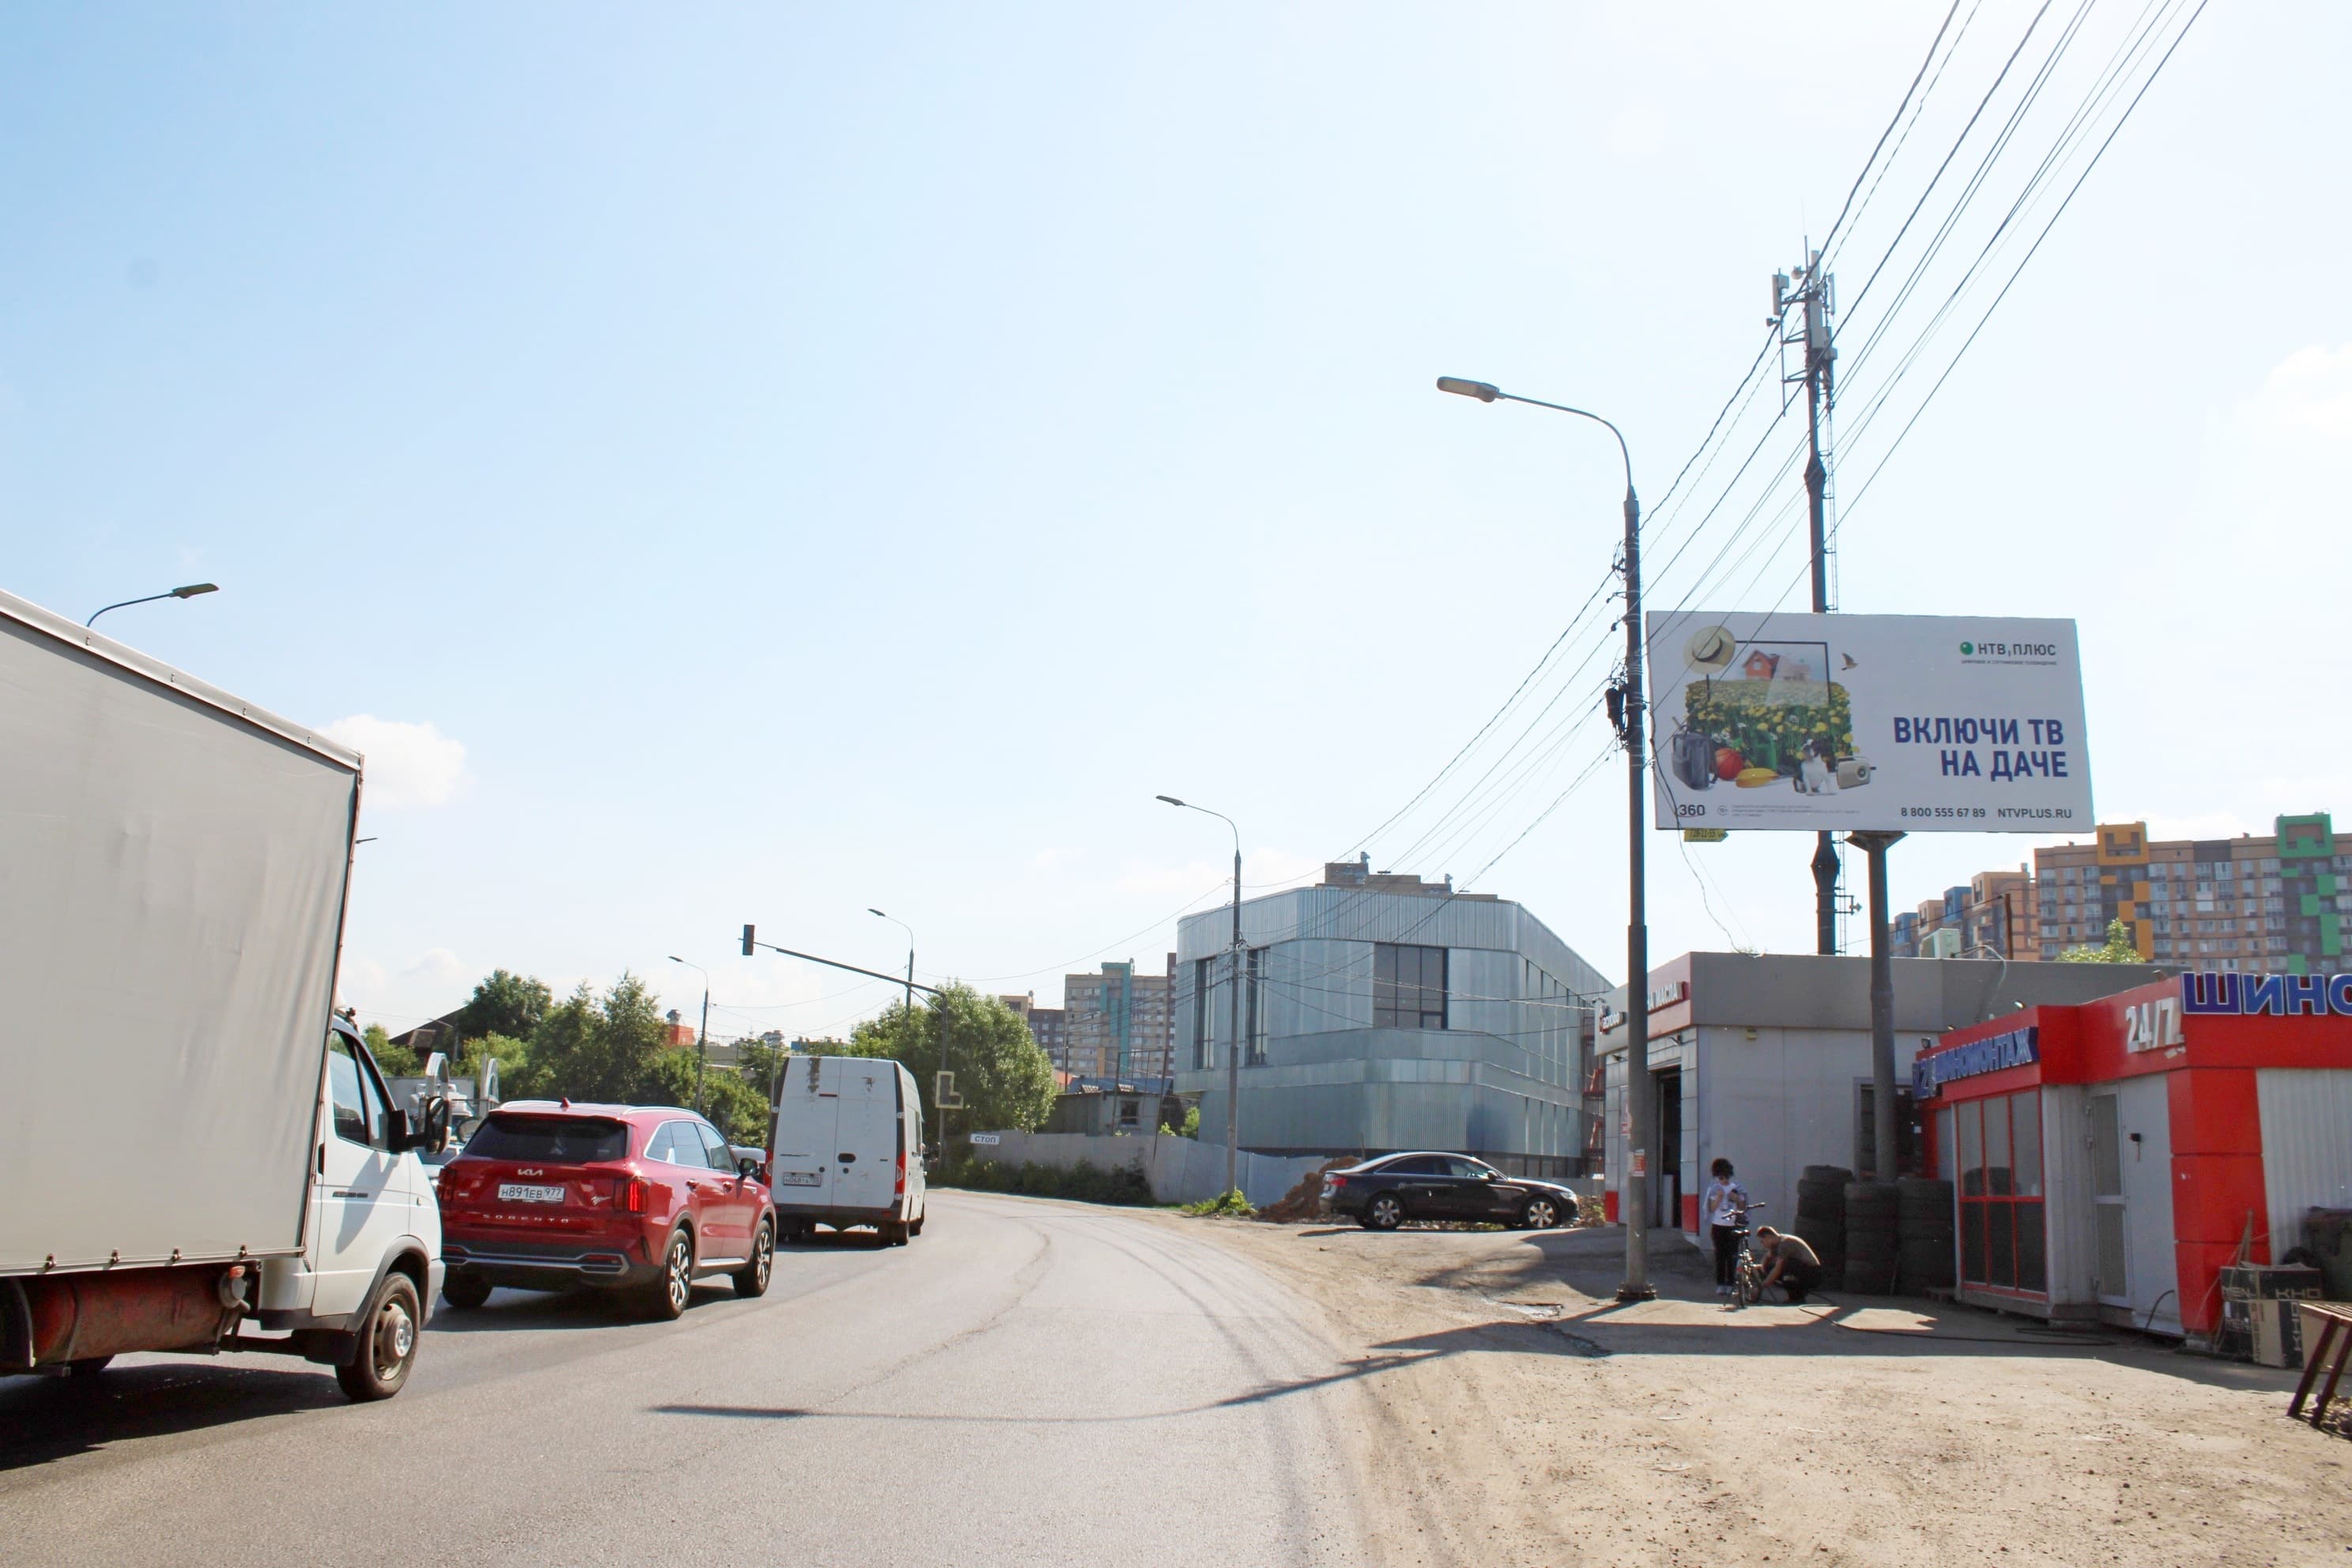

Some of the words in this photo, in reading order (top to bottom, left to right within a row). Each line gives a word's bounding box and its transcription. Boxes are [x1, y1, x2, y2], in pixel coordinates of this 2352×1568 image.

[1894, 717, 2019, 744] ВКЛЮЧИ
[2028, 719, 2064, 745] ТВ
[1941, 750, 1981, 776] НА
[1990, 751, 2068, 782] ДАЧЕ
[1677, 804, 1706, 816] 360
[1901, 807, 1908, 817] 8
[1910, 807, 1932, 817] 800
[1935, 807, 1954, 818] 555
[1957, 808, 1969, 818] 67
[1973, 808, 1986, 818] 89
[1998, 808, 2072, 819] NTVPLUS.RU
[2125, 997, 2182, 1054] 24/7
[483, 1214, 569, 1223] SORENTO
